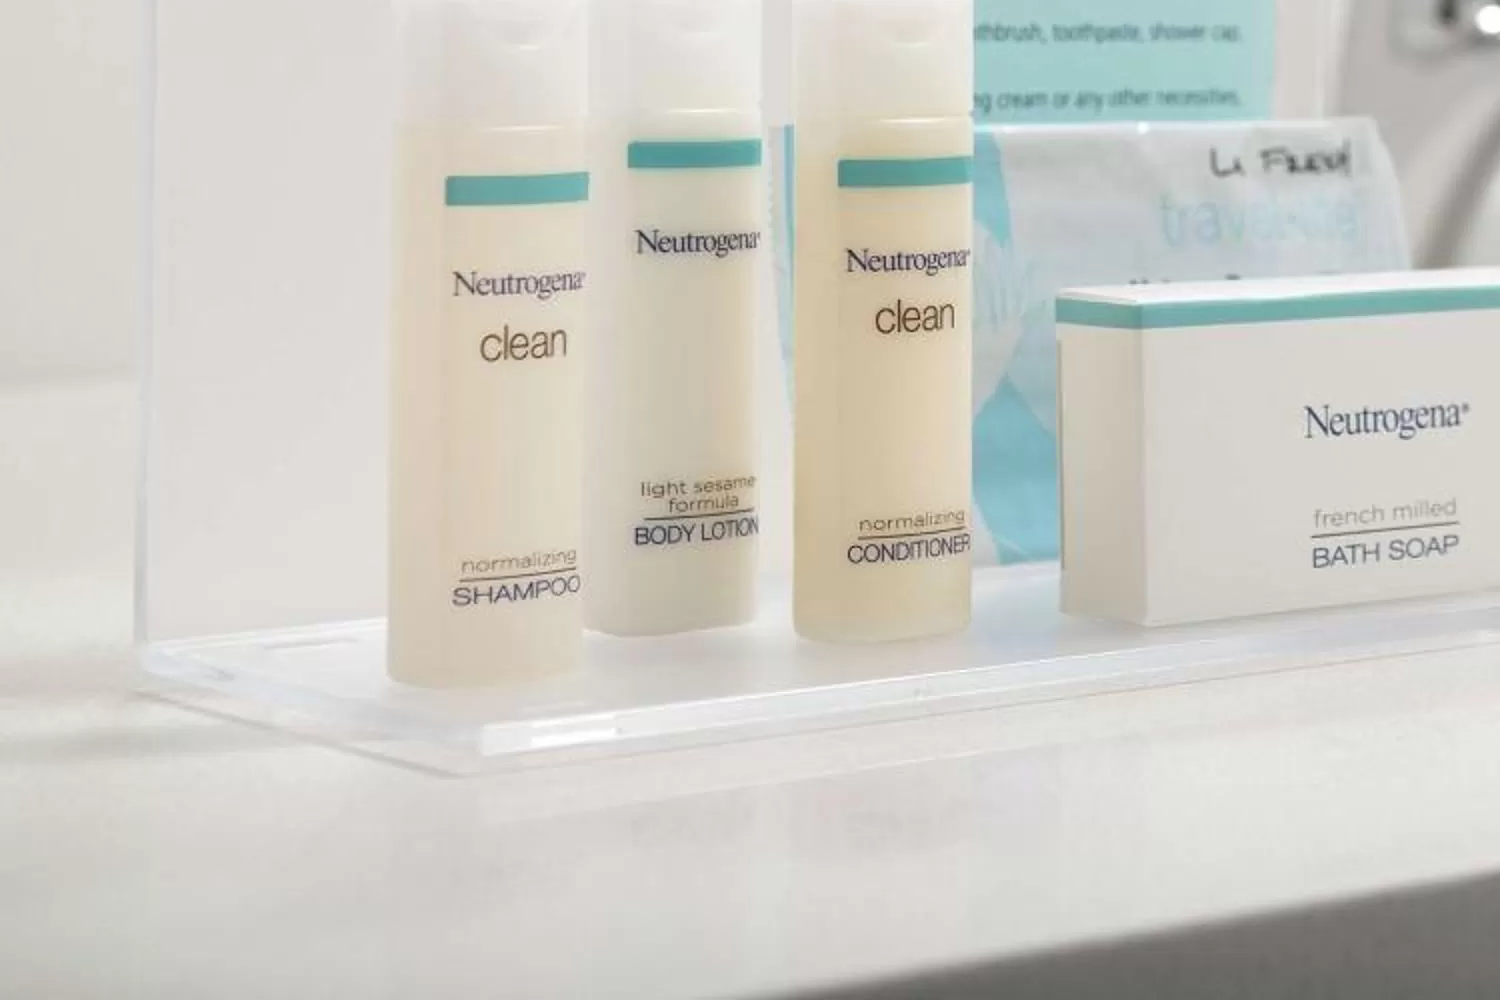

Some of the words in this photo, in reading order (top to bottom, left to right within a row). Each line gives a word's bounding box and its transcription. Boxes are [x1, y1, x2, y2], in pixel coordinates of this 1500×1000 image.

[1149, 21, 1204, 41] shower
[997, 91, 1048, 110] cream
[1052, 92, 1070, 109] or
[1073, 91, 1103, 114] any
[1108, 87, 1149, 107] other
[875, 298, 955, 334] clean
[480, 323, 567, 363] clean
[640, 481, 688, 499] light
[693, 476, 757, 493] sesame
[669, 495, 739, 513] formula
[1313, 503, 1385, 528] french
[1392, 498, 1457, 520] milled
[634, 522, 697, 545] BODY
[701, 515, 759, 542] LOTION
[859, 510, 965, 532] normalizing
[461, 549, 577, 574] normalizing
[847, 533, 970, 564] CONDITIONER
[1312, 541, 1381, 568] BATH
[1388, 534, 1460, 560] SOAP
[452, 574, 581, 606] SHAMPOO
